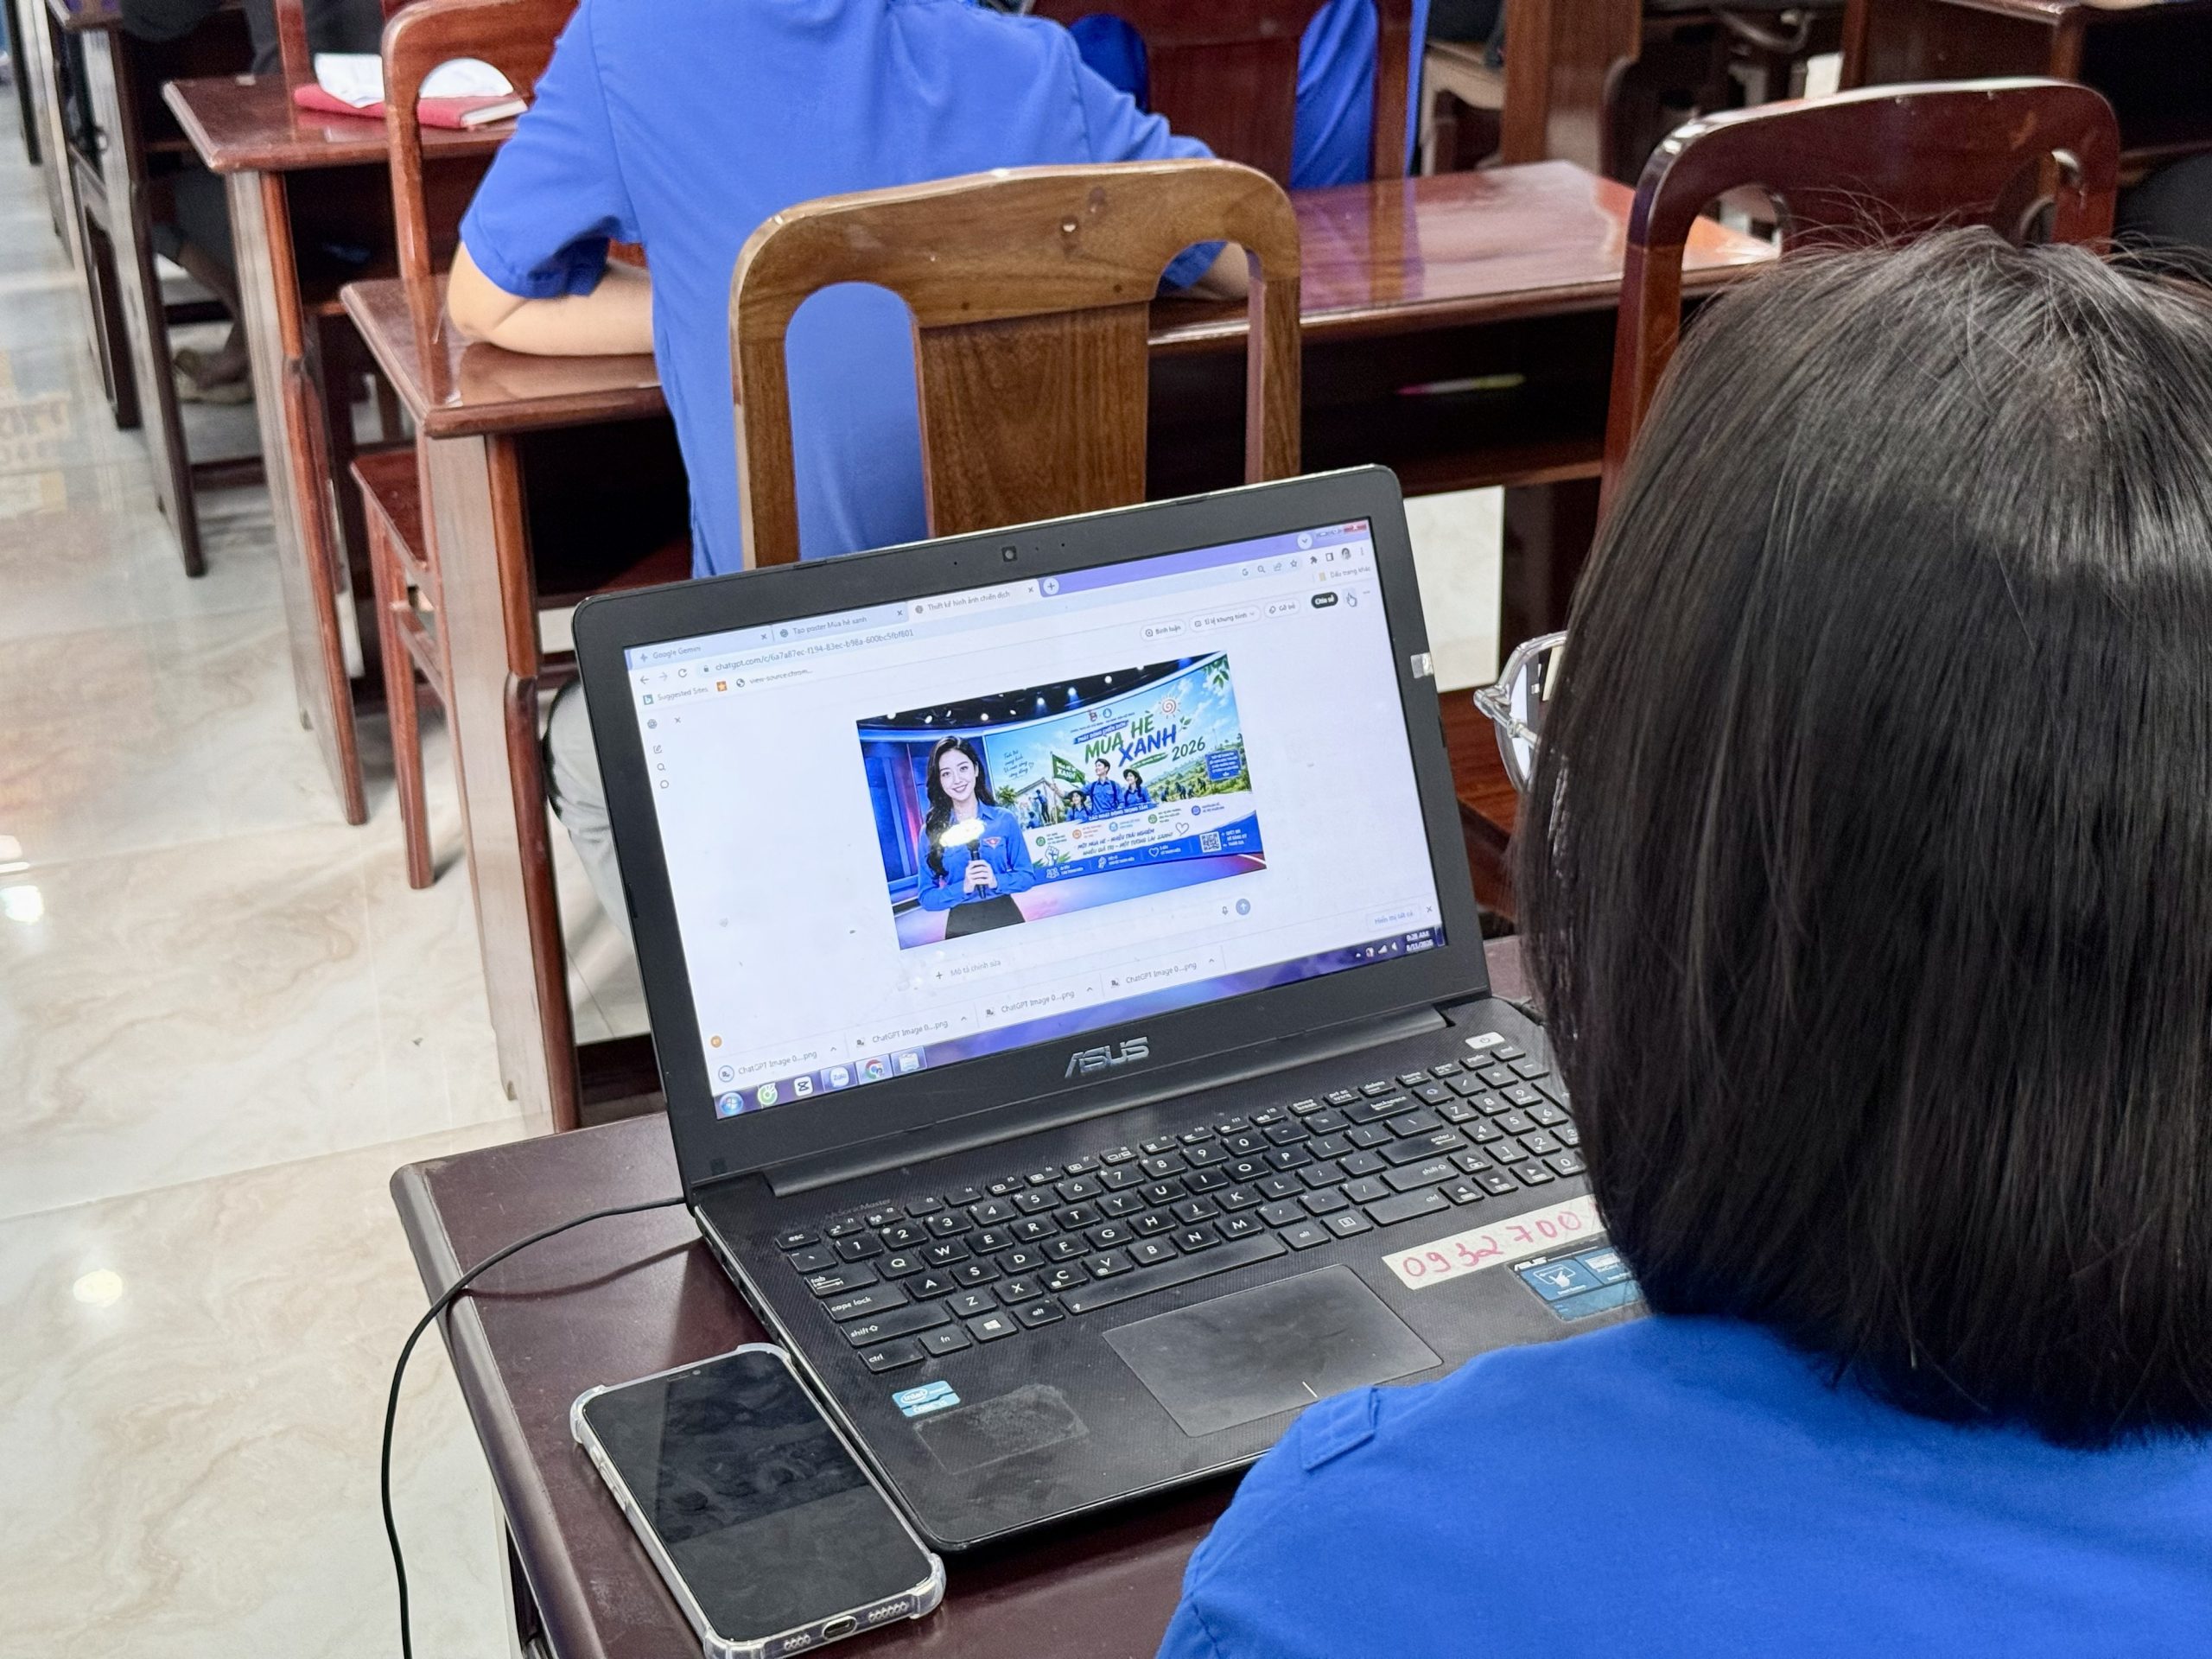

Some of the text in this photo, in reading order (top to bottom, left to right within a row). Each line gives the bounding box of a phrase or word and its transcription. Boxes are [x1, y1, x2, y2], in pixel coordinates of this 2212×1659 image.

[805, 623, 827, 633] poster
[652, 648, 677, 660] Google
[657, 685, 709, 702] Suggested Sites
[1084, 730, 1124, 764] MÙA
[1131, 710, 1155, 738] HÈ
[1117, 724, 1177, 768] XANH
[1172, 737, 1206, 762] 2026
[1125, 970, 1152, 983] ChatGPT
[1153, 966, 1173, 978] Image
[1001, 1000, 1028, 1013] ChatGPT
[1029, 995, 1050, 1007] Image
[872, 1030, 899, 1043] ChatGPT
[901, 1025, 923, 1038] Image
[1064, 1036, 1150, 1078] ASUS
[738, 1061, 767, 1075] ChatGPT
[769, 1056, 791, 1069] Image
[1370, 1096, 1408, 1109] backspace
[1484, 1097, 1495, 1106] 8
[1450, 1106, 1459, 1115] 7
[1543, 1109, 1553, 1117] 6
[1510, 1116, 1520, 1125] 5
[1239, 1138, 1249, 1147] 0
[1430, 1134, 1450, 1143] enter
[1534, 1137, 1547, 1146] 2
[1501, 1146, 1510, 1154] 1
[1281, 1152, 1290, 1161] P
[1156, 1160, 1167, 1168] 8
[1560, 1159, 1572, 1167] 0
[1238, 1163, 1251, 1173] O
[1114, 1171, 1122, 1180] 7
[1200, 1174, 1208, 1184] I
[1074, 1183, 1083, 1192] 6
[1155, 1185, 1167, 1195] U
[1274, 1181, 1285, 1190] L
[1031, 1195, 1040, 1204] 5
[1230, 1192, 1243, 1201] K
[1113, 1198, 1122, 1207] Y
[1192, 1204, 1199, 1213] J
[1070, 1211, 1079, 1220] T
[942, 1218, 953, 1227] 3
[1145, 1217, 1158, 1227] H
[1231, 1219, 1248, 1230] M
[1027, 1223, 1039, 1232] R
[897, 1230, 909, 1239] 2
[1102, 1229, 1116, 1238] G
[1188, 1231, 1202, 1243] N
[983, 1235, 994, 1244] E
[853, 1242, 861, 1250] 1
[934, 1245, 950, 1255] W
[1058, 1242, 1068, 1251] F
[1147, 1245, 1158, 1255] B
[891, 1258, 906, 1267] Q
[1013, 1255, 1026, 1264] D
[1100, 1257, 1110, 1267] V
[969, 1267, 980, 1276] S
[1056, 1270, 1069, 1280] C
[810, 1275, 826, 1285] tab
[925, 1279, 938, 1289] A
[1011, 1283, 1024, 1294] X
[853, 1297, 872, 1306] lock
[966, 1296, 978, 1306] Z
[1032, 1307, 1044, 1316] alt
[850, 1327, 869, 1338] shift
[868, 1353, 885, 1363] ctrl
